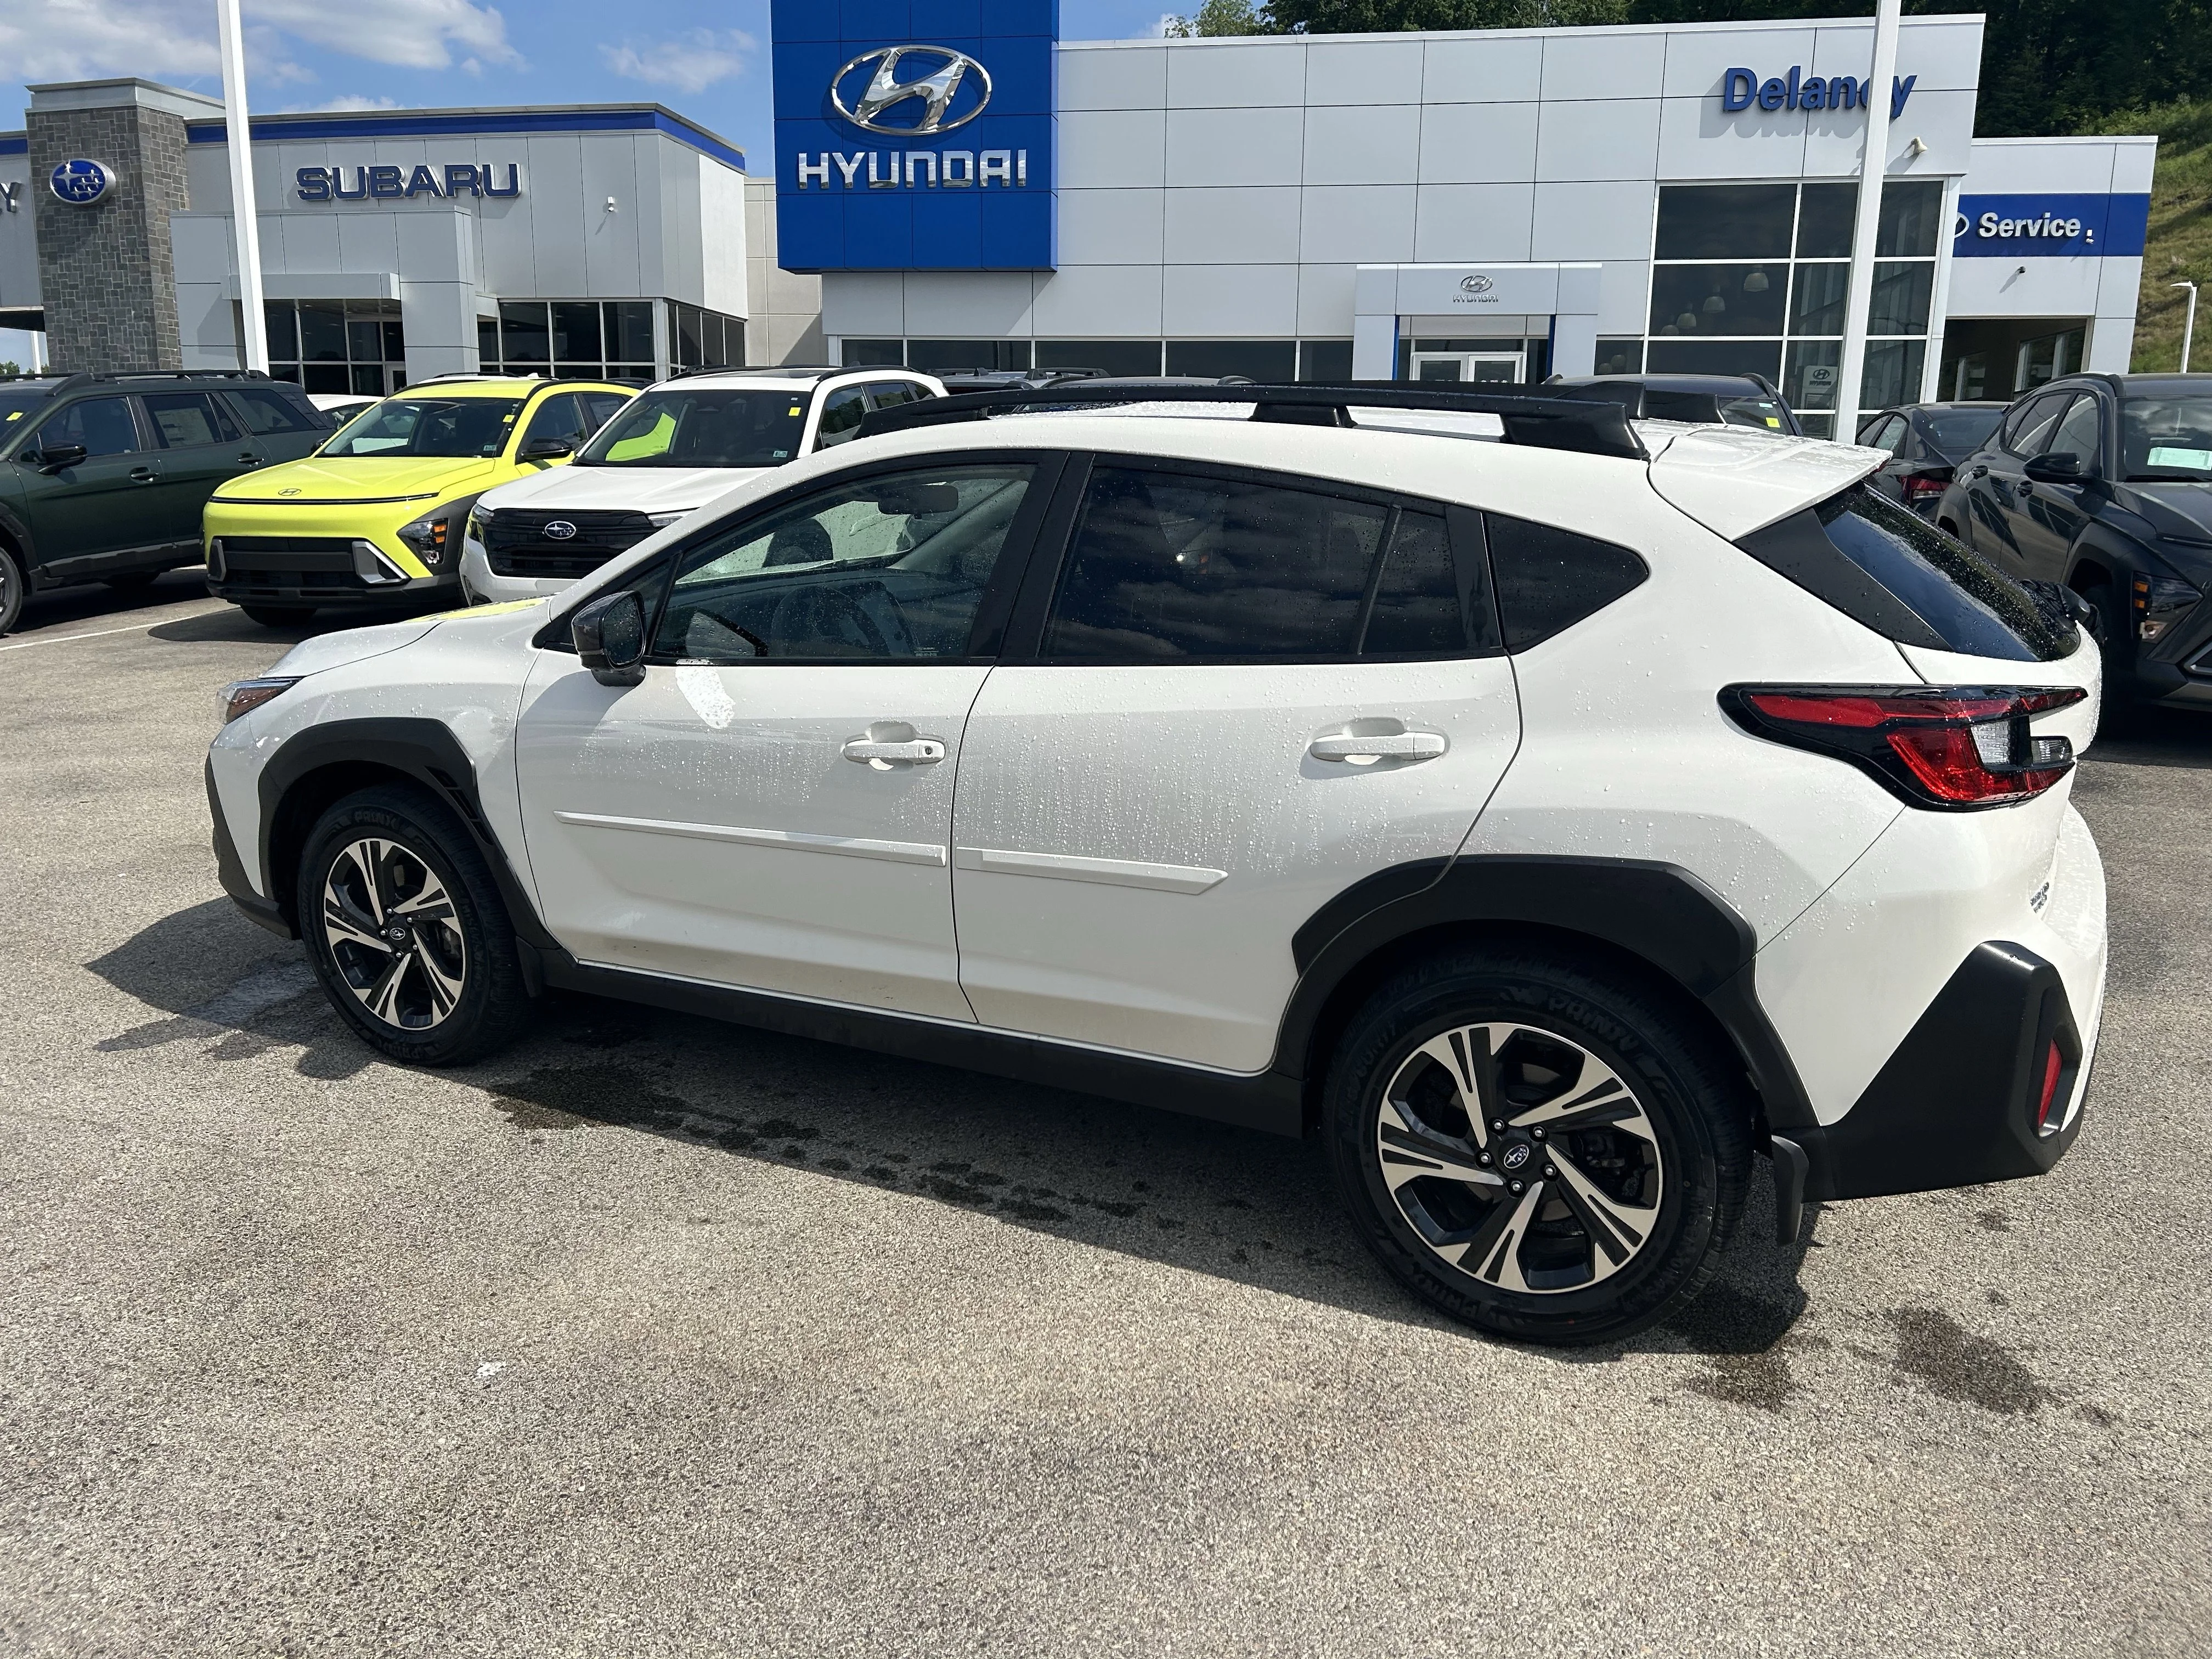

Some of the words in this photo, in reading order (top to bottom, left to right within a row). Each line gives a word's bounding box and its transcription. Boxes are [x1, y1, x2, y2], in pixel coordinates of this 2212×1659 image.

[296, 163, 521, 201] SUBARU
[798, 149, 1027, 190] HYUNDAI
[1978, 212, 2081, 238] Service
[1453, 295, 1498, 303] HYUNDAI
